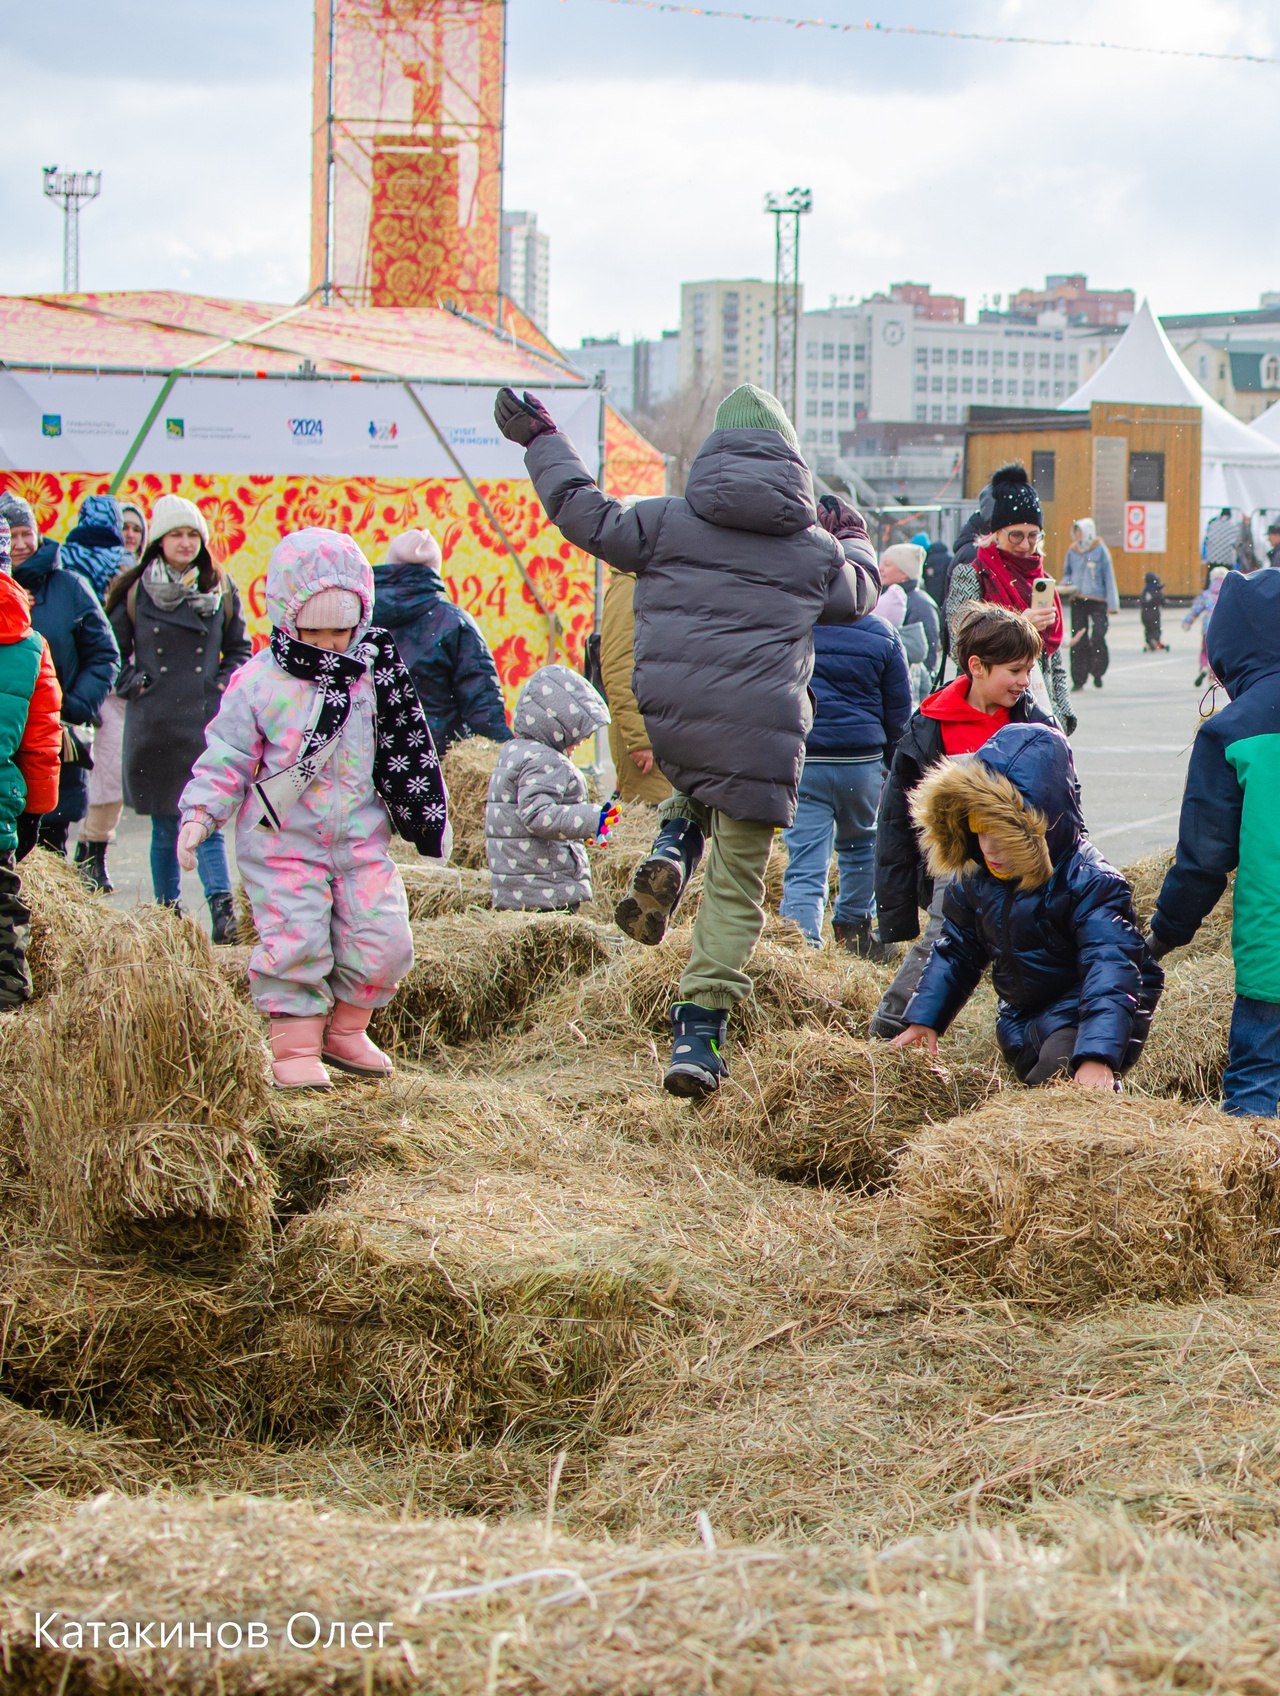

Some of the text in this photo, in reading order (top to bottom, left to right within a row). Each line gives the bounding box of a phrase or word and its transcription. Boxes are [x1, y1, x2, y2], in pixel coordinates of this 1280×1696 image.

[292, 418, 323, 436] 2024
[454, 427, 476, 435] VISIT
[453, 437, 500, 446] PRIMORYE
